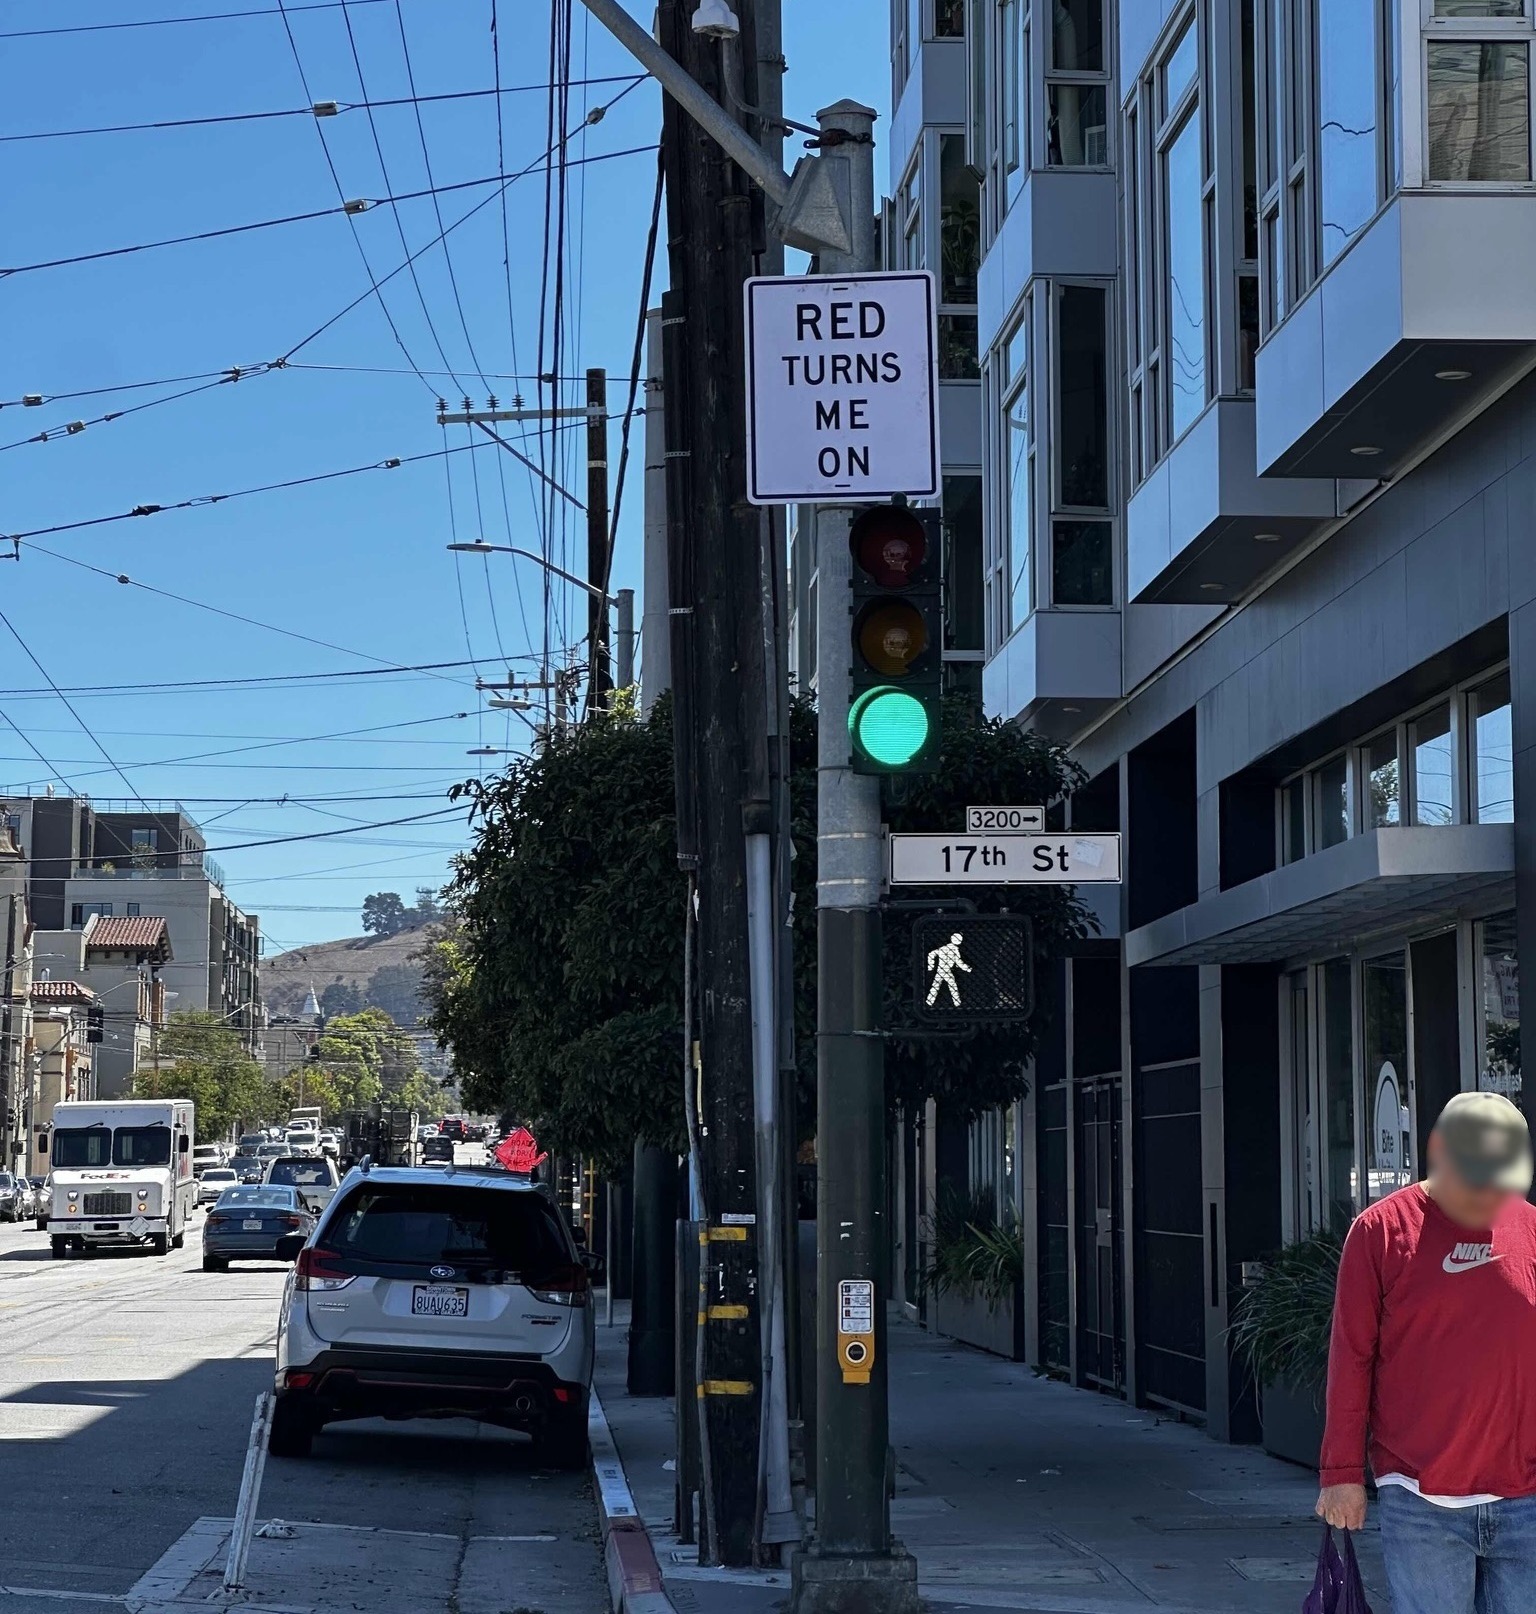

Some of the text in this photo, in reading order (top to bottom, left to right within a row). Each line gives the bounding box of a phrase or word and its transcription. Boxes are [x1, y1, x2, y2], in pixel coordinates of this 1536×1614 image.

[796, 301, 885, 341] RED
[781, 352, 902, 386] TURNS
[816, 399, 869, 430] ME
[818, 446, 870, 478] ON
[971, 810, 1021, 829] 3200
[942, 845, 1006, 873] 17th
[1032, 844, 1069, 872] St
[80, 1172, 131, 1180] FedEx
[1451, 1242, 1492, 1261] NIKE
[416, 1296, 464, 1311] 8UAU635
